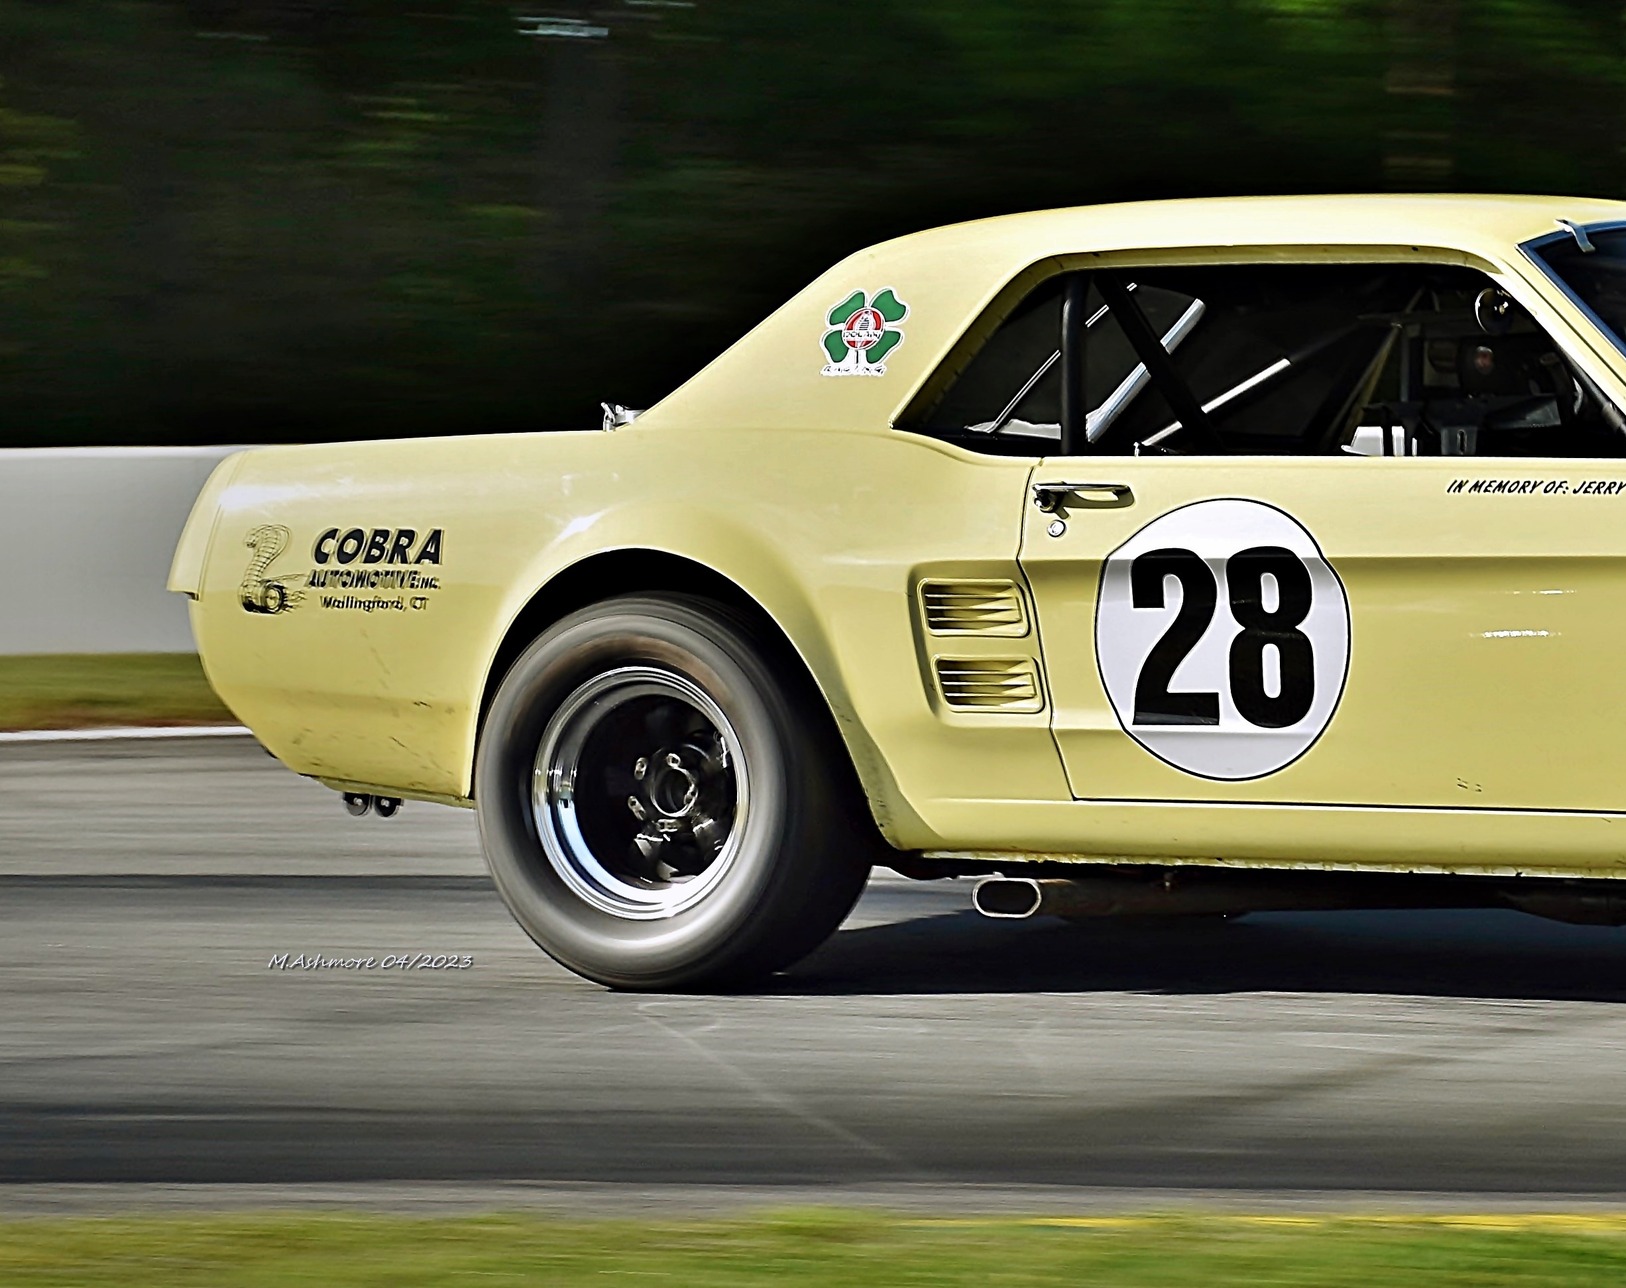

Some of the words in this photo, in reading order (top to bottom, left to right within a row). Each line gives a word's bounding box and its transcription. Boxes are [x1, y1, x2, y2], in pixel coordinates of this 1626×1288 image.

[1447, 480, 1468, 493] IN
[1469, 480, 1543, 494] MEMORY
[1543, 481, 1569, 494] OF:
[314, 528, 444, 565] COBRA
[320, 595, 407, 612] Wallingford,
[410, 597, 429, 610] CT
[1131, 546, 1315, 729] 28
